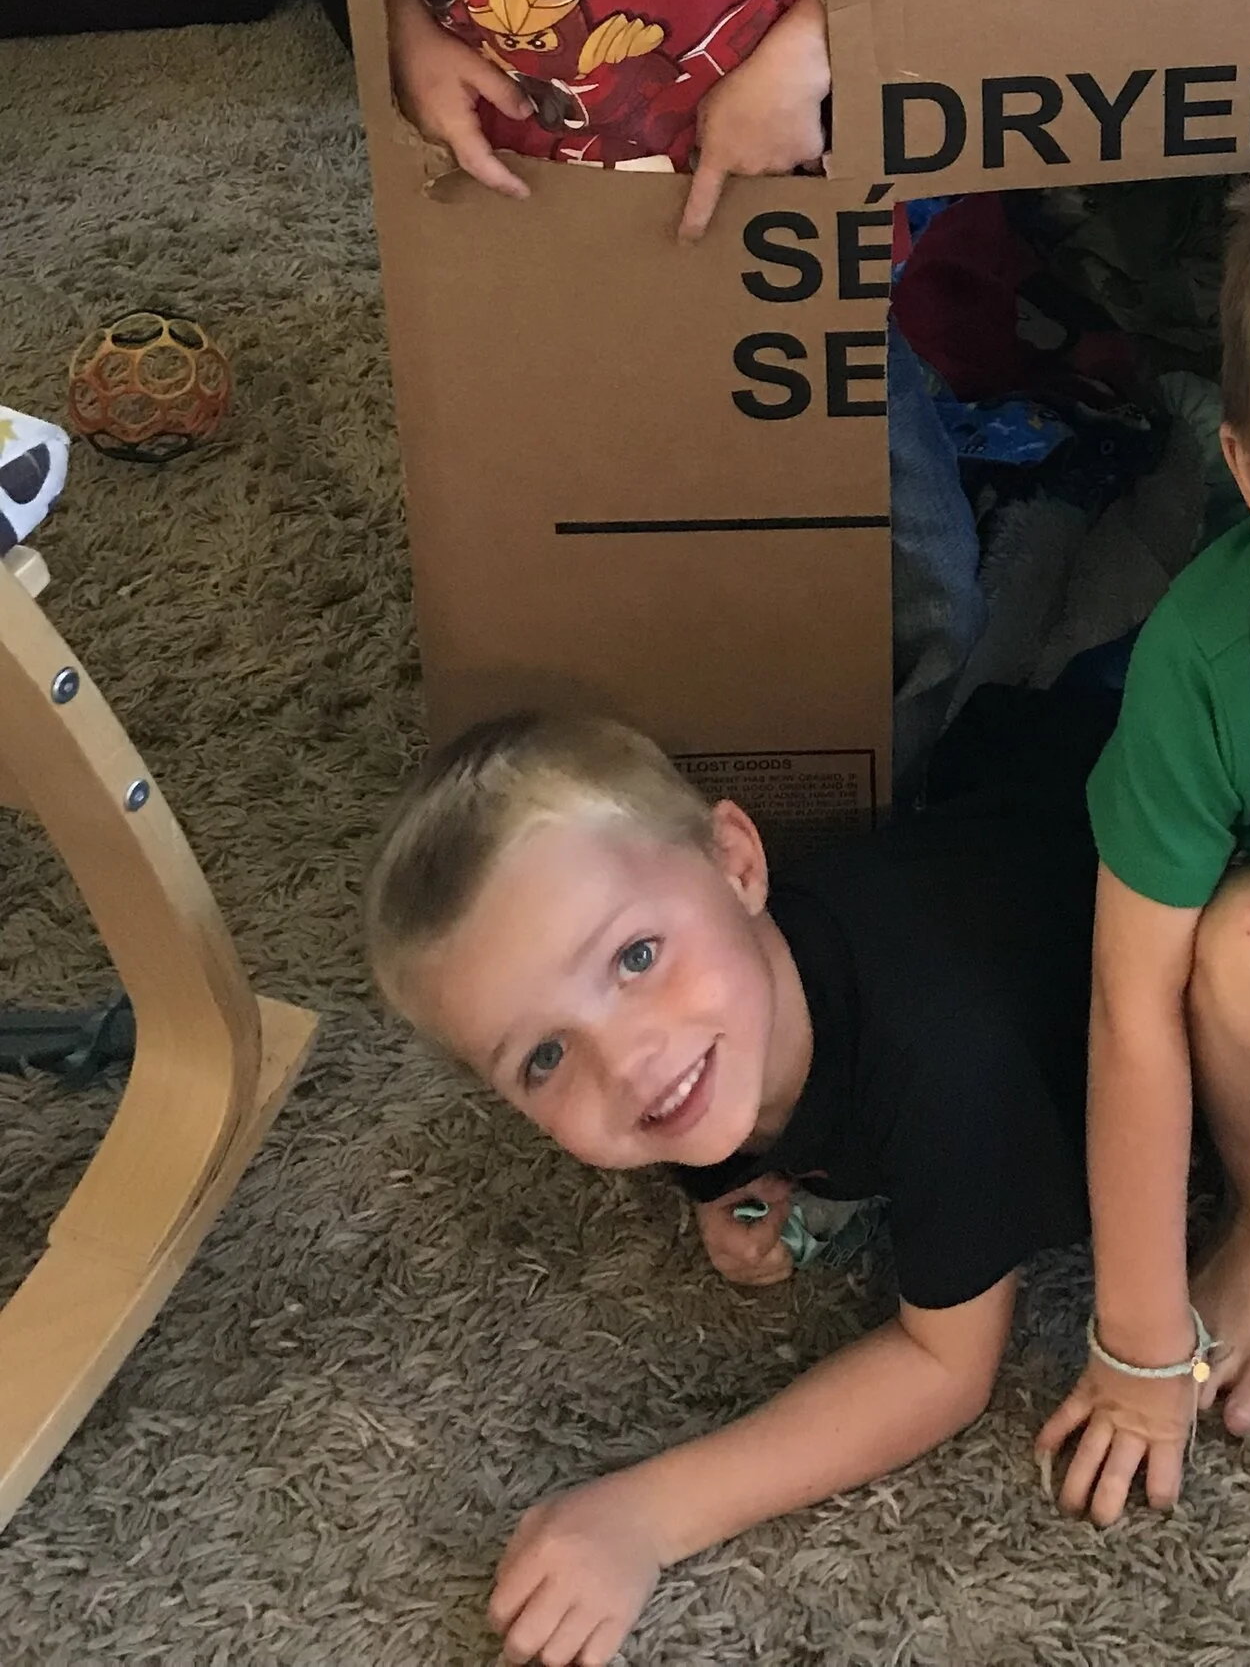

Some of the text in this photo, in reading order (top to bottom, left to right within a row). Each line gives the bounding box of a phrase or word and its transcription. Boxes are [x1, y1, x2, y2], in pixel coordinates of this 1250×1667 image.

[741, 183, 895, 302] SÉ
[731, 332, 888, 419] SE
[687, 760, 729, 773] LOST
[733, 759, 792, 772] GOODS
